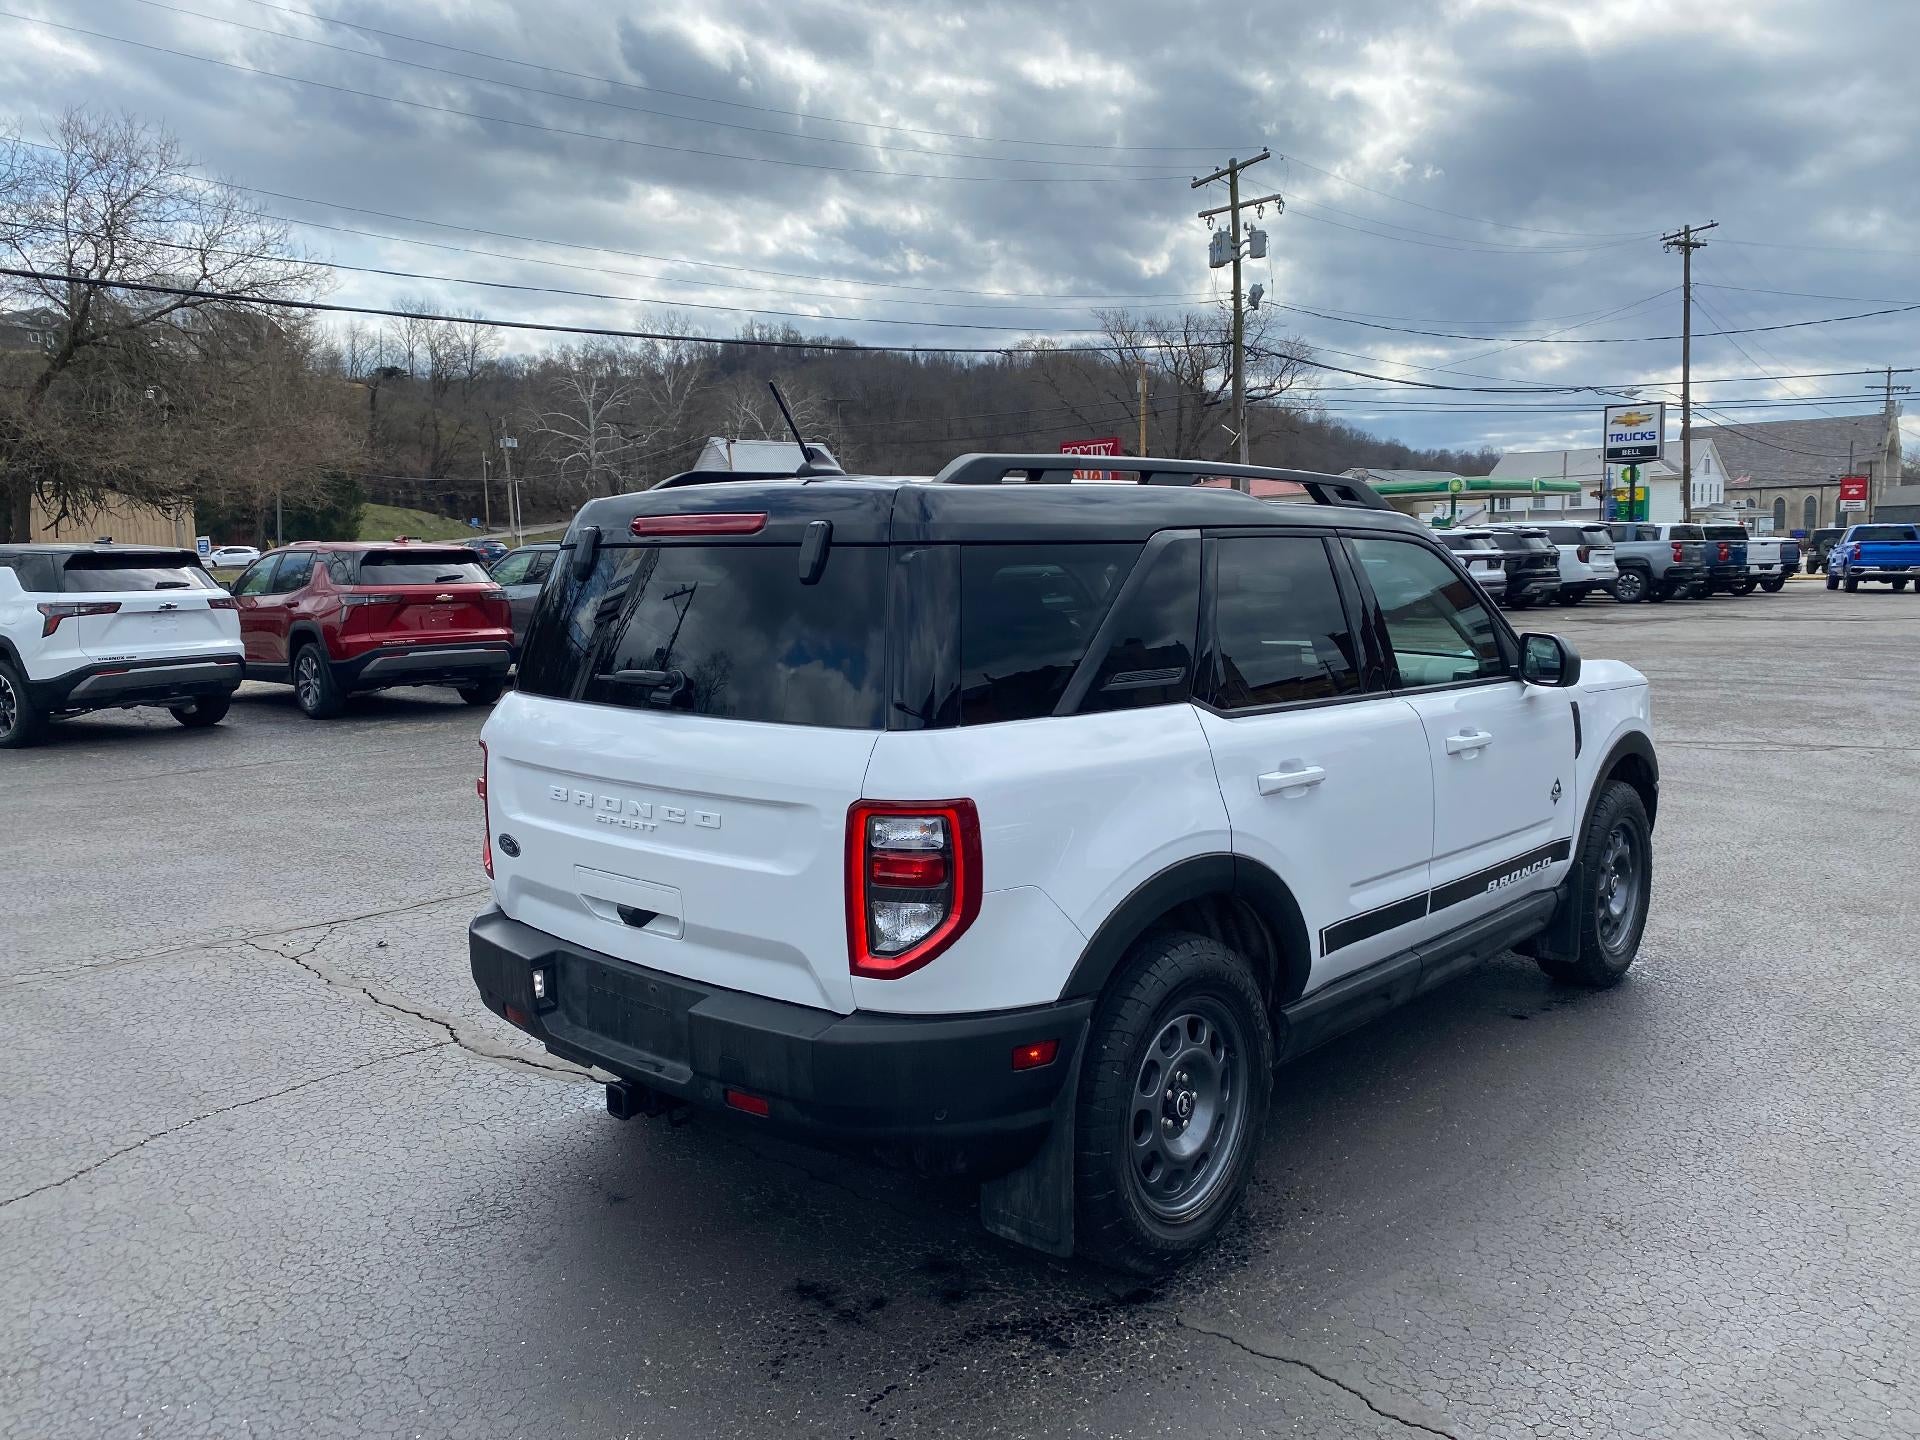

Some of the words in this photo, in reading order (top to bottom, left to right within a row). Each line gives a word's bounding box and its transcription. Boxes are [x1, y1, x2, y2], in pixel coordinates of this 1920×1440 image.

[1608, 430, 1656, 443] TRUCKS
[1621, 448, 1641, 456] BELL
[549, 784, 721, 829] BRONCO
[594, 812, 657, 832] SPORT
[1487, 856, 1552, 893] BRONCO
